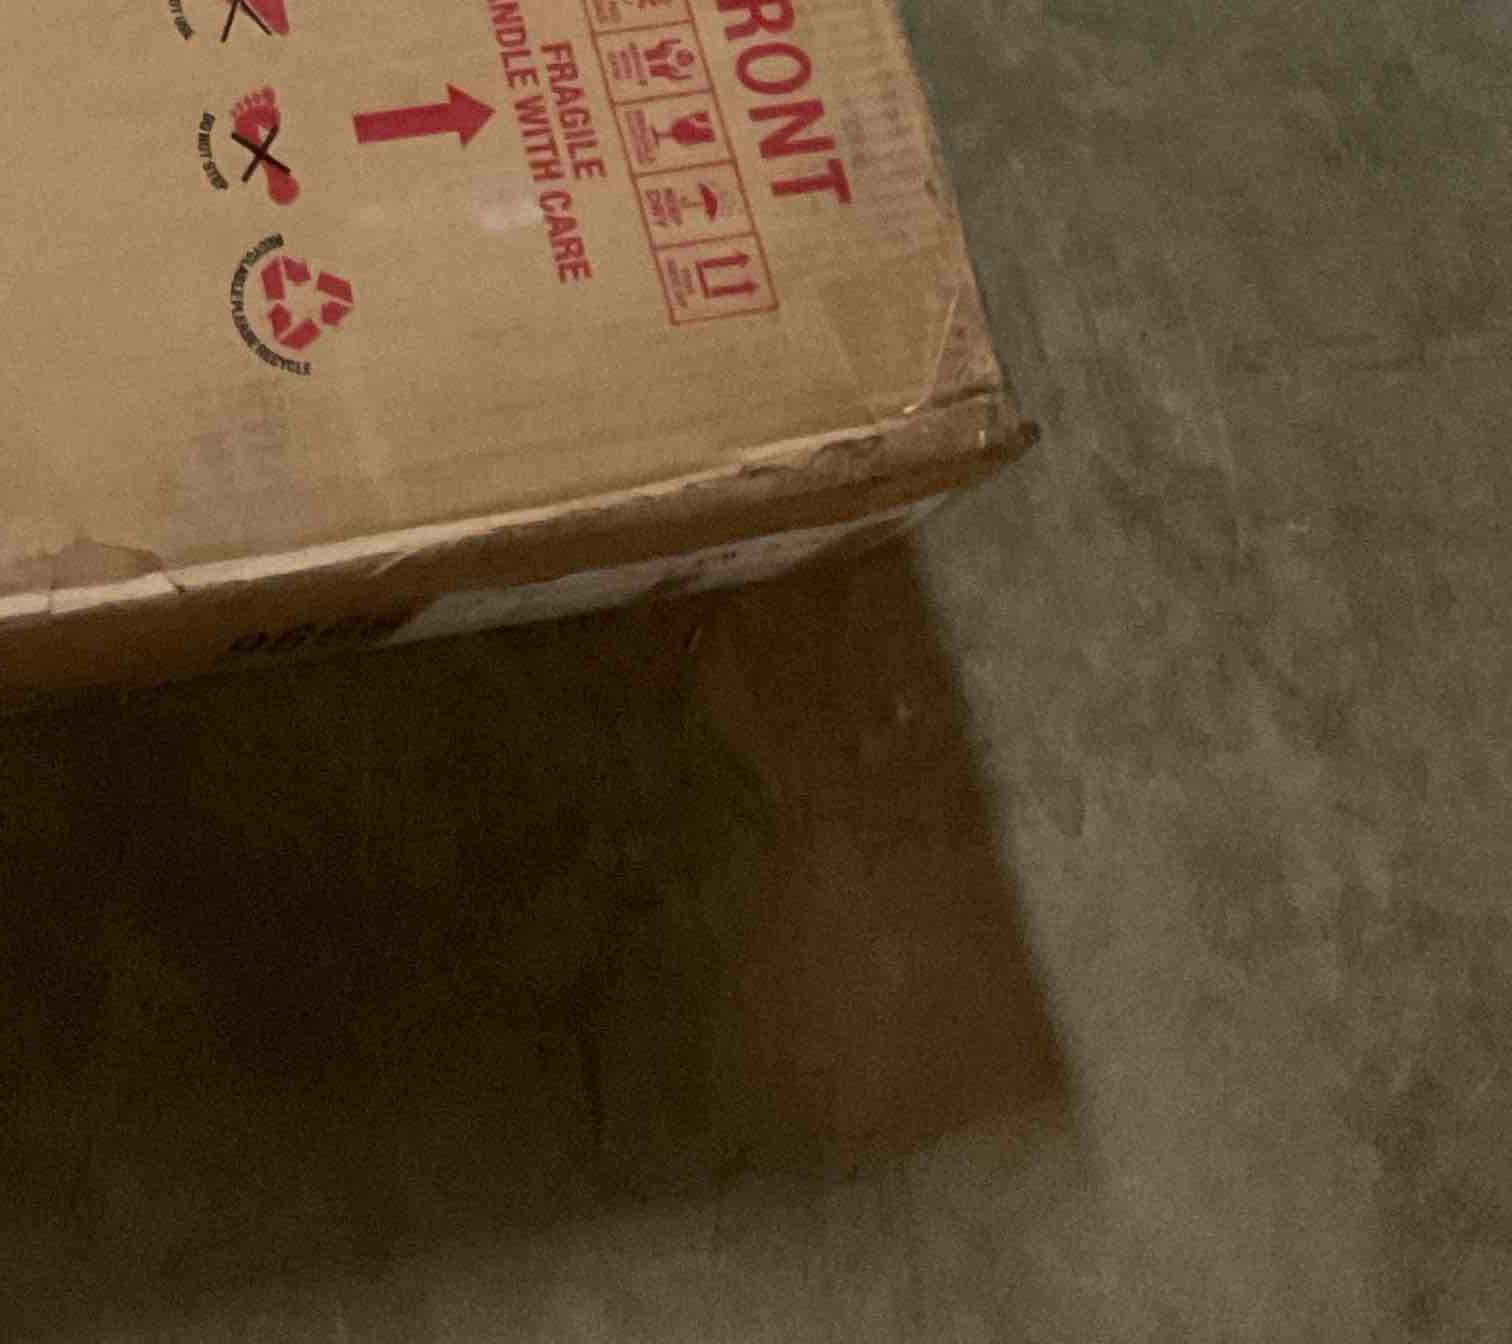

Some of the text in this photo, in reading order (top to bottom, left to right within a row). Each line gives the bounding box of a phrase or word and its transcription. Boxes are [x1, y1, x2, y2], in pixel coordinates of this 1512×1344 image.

[515, 96, 565, 183] WITH
[541, 42, 607, 180] FRAGILE
[539, 191, 592, 284] CARE
